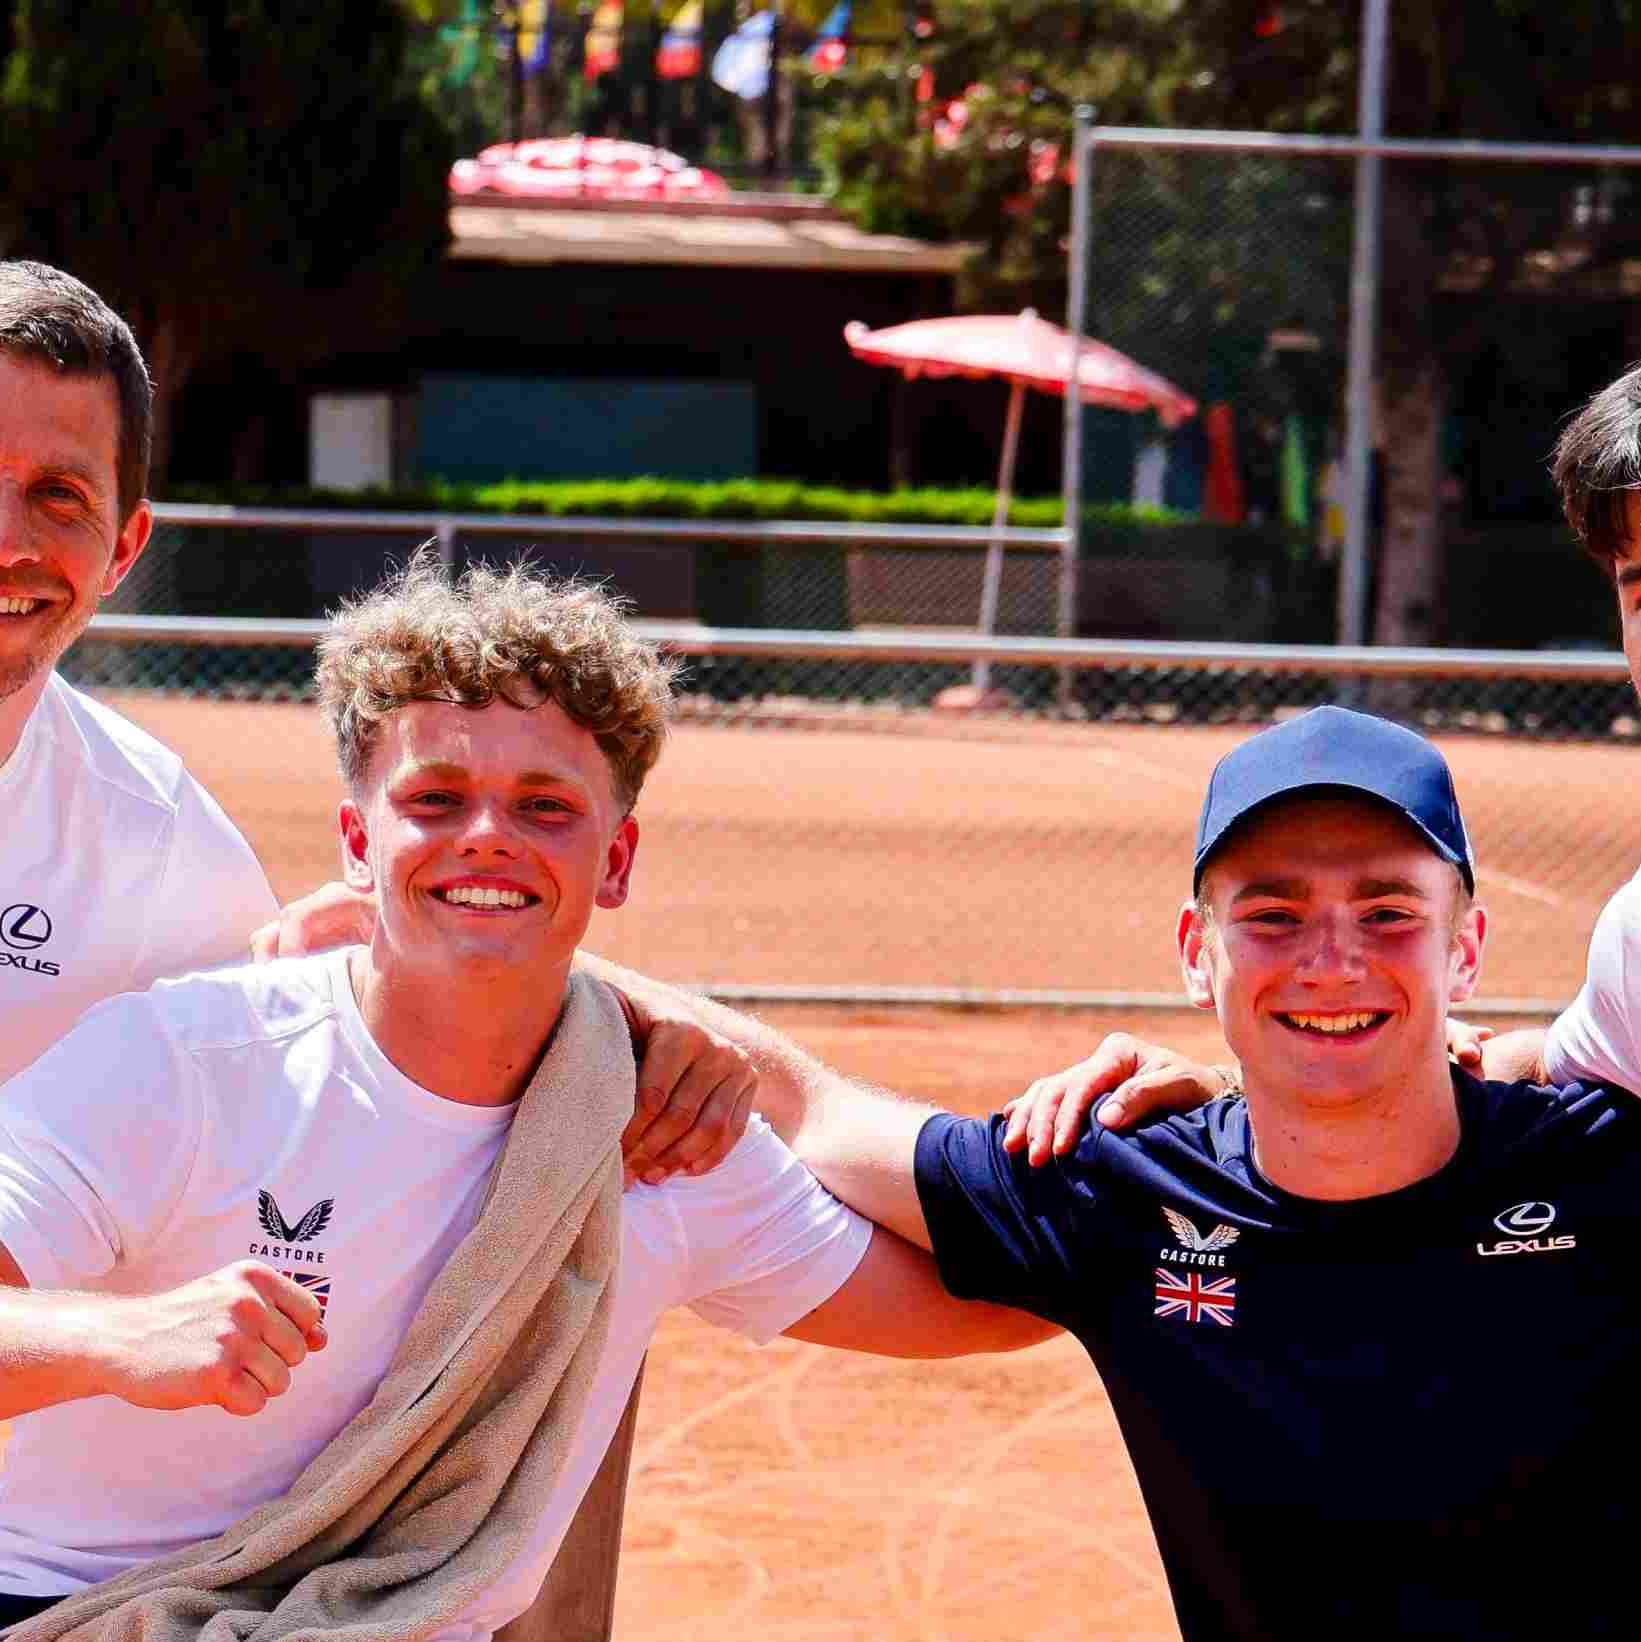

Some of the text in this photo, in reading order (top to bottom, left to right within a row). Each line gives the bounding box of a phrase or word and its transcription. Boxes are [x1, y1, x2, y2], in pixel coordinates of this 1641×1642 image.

[249, 1243, 327, 1264] CASTORE
[1476, 1235, 1577, 1256] LEXUS
[1160, 1248, 1226, 1267] CASTORE
